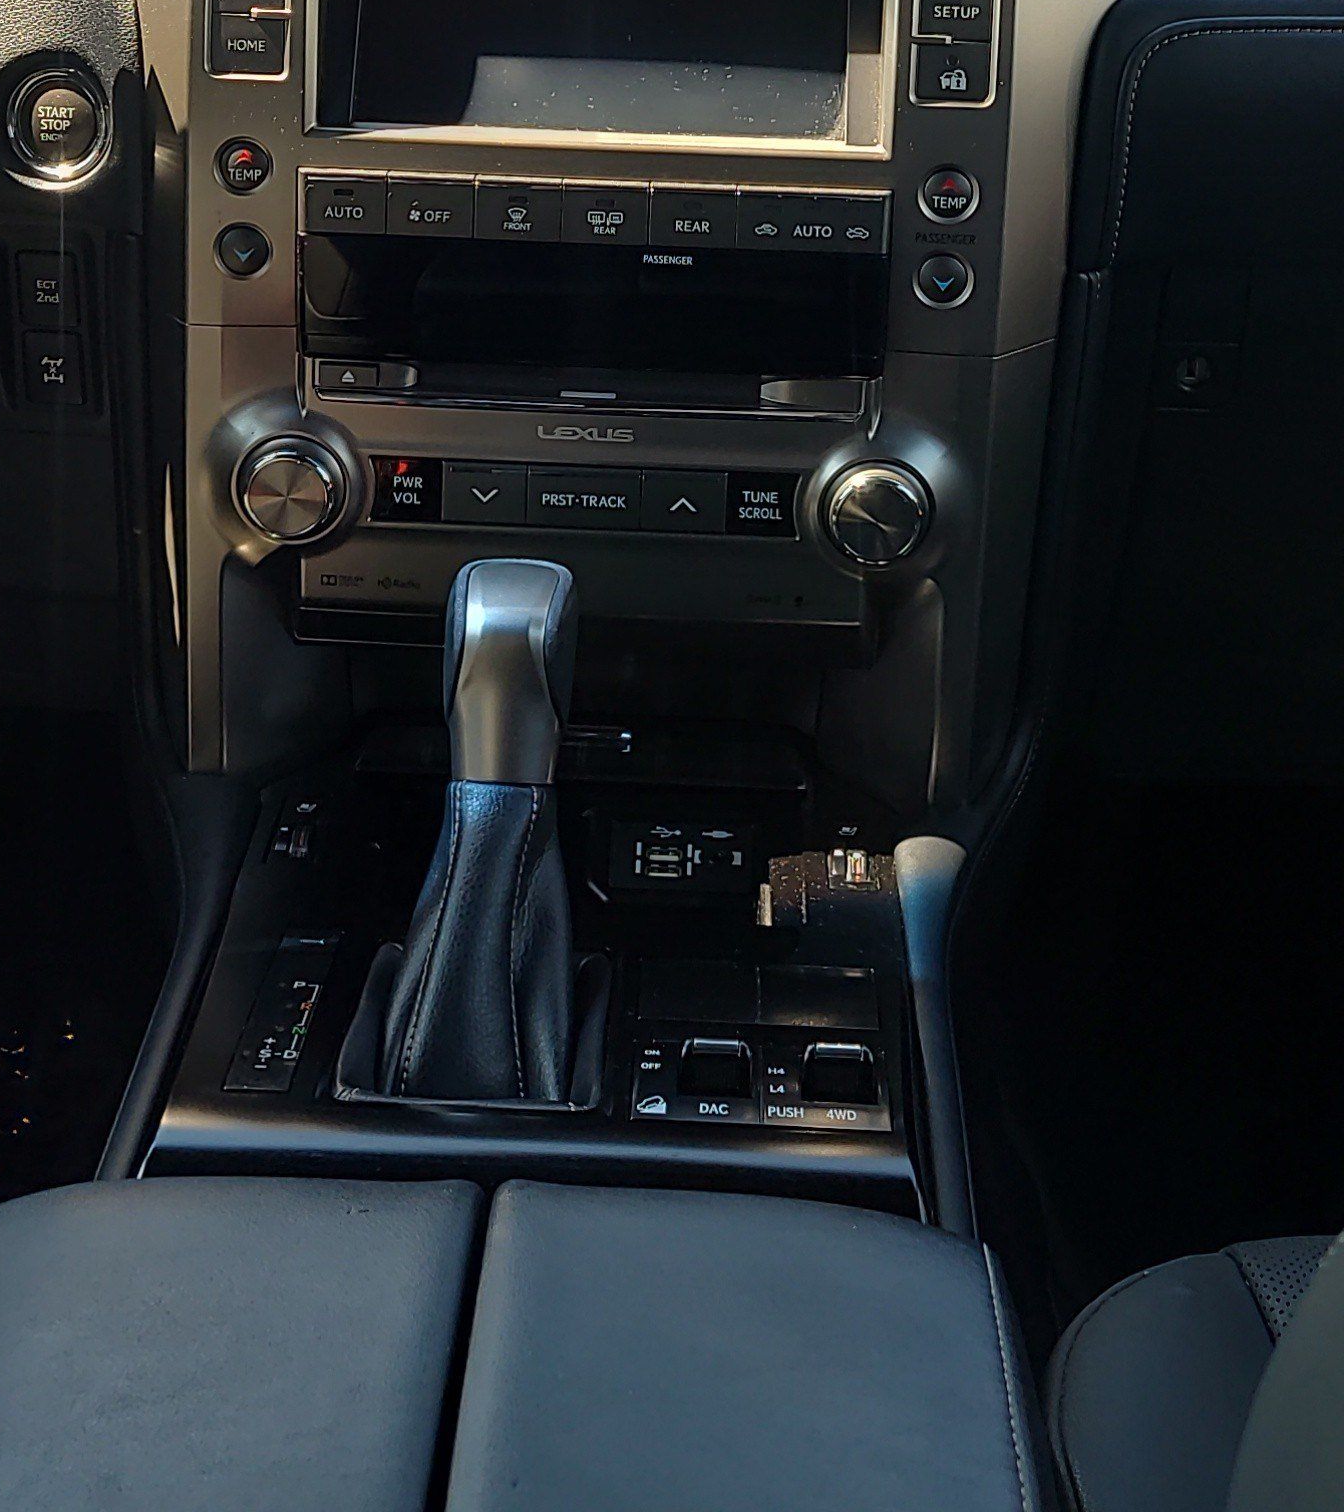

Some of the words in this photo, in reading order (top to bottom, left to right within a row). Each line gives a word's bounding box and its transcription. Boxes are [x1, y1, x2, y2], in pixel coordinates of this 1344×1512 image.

[933, 6, 980, 19] SETUP
[227, 39, 266, 52] HOME
[37, 106, 76, 119] START
[40, 119, 71, 131] STOP
[40, 133, 64, 141] ENG
[228, 167, 262, 181] TEMP
[932, 195, 967, 209] TEMP
[324, 206, 363, 219] AUTO
[423, 210, 451, 223] OFF
[503, 221, 532, 231] FRONT
[593, 226, 616, 236] REAR
[675, 220, 710, 233] REAR
[793, 225, 832, 238] AUTO
[915, 232, 978, 245] PASSENGER
[643, 254, 693, 266] PASSENGER
[36, 280, 57, 289] ECT
[36, 292, 60, 303] 2nd
[537, 425, 635, 443] LEXUS
[393, 476, 423, 489] PWR
[393, 492, 421, 505] VOL
[742, 491, 779, 504] TUNE
[738, 507, 783, 520] SCROLL
[293, 981, 306, 989] P
[292, 1026, 306, 1035] N
[283, 1049, 297, 1059] D
[640, 1062, 661, 1071] OFF
[767, 1066, 786, 1076] H4
[769, 1084, 786, 1094] L4
[699, 1103, 730, 1116] DAC
[767, 1106, 804, 1119] PUSH
[825, 1110, 857, 1121] 4WD
